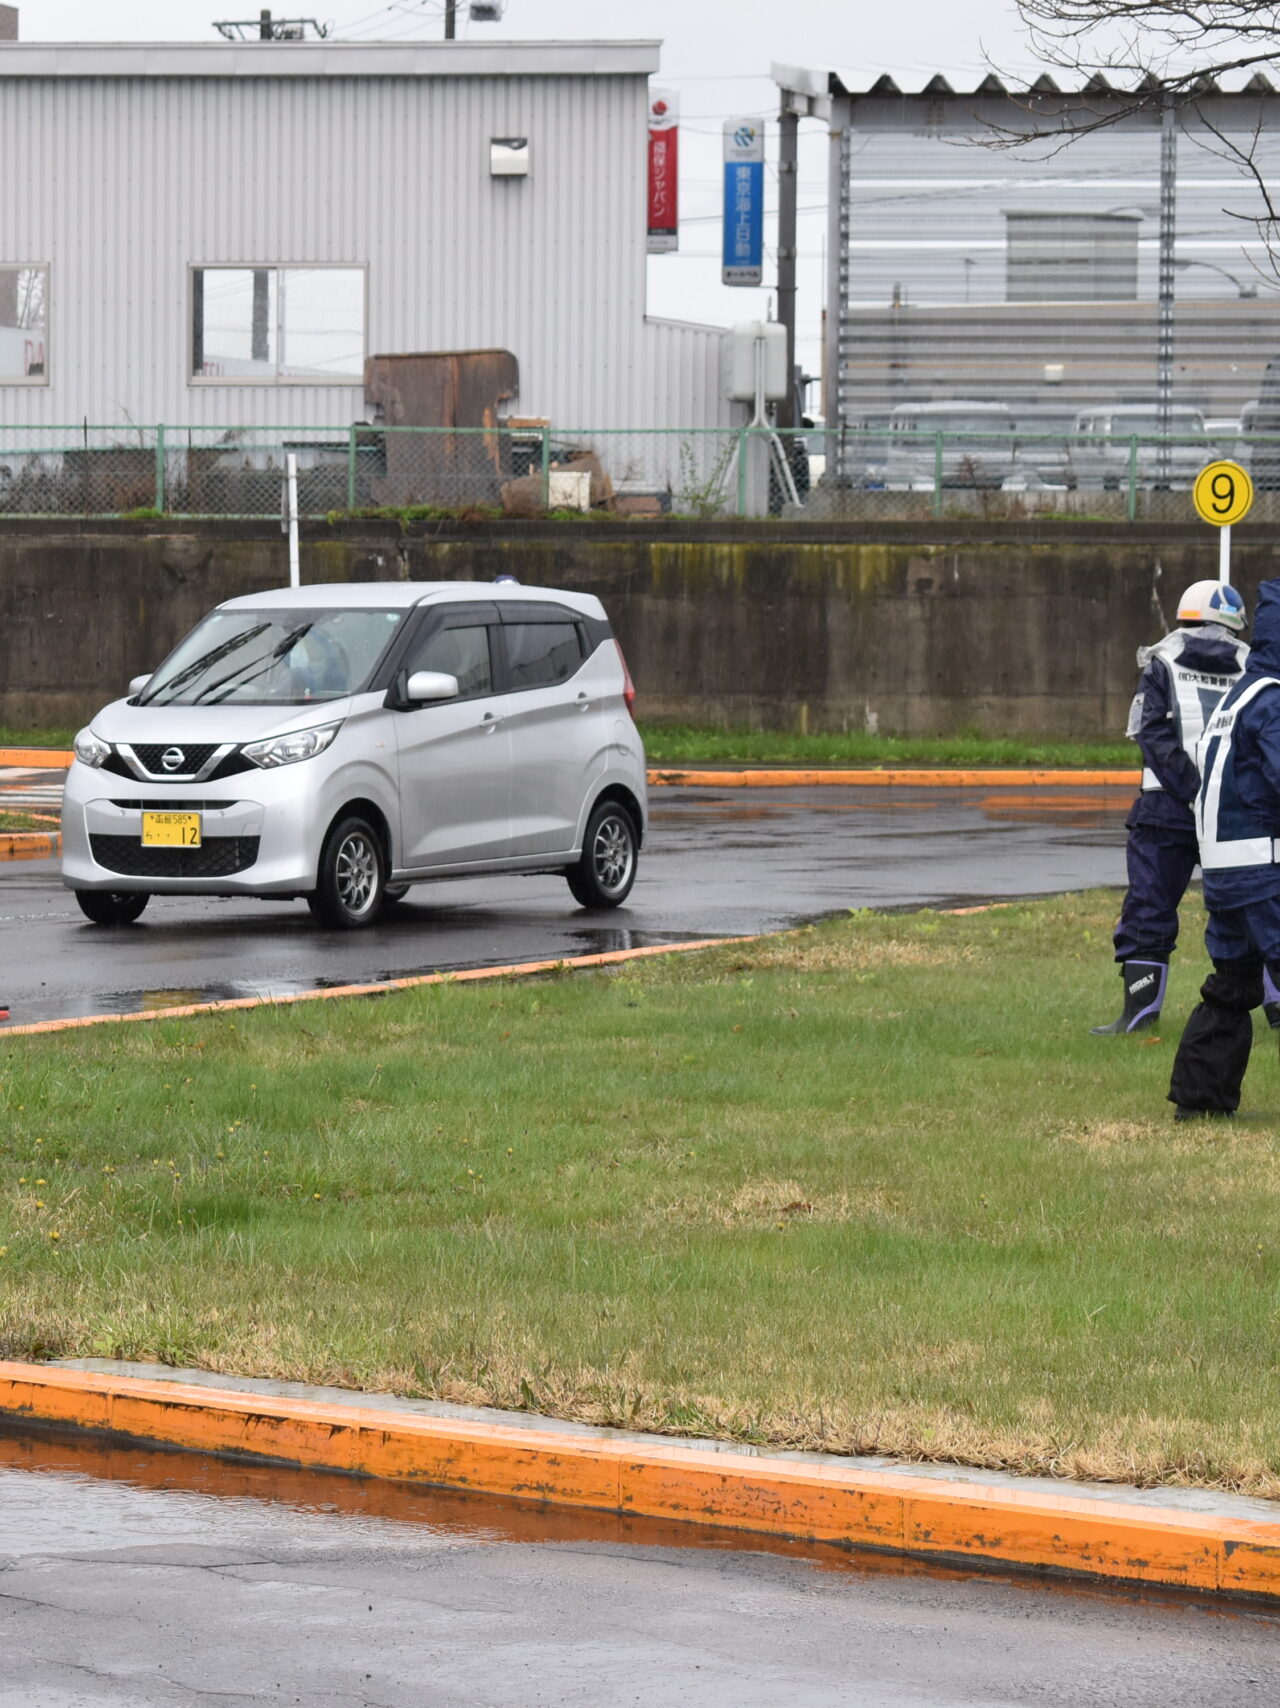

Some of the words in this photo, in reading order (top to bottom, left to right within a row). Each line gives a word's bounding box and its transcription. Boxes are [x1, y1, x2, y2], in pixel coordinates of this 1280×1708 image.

[735, 165, 752, 258] 東京海上日動
[1211, 473, 1235, 514] 9
